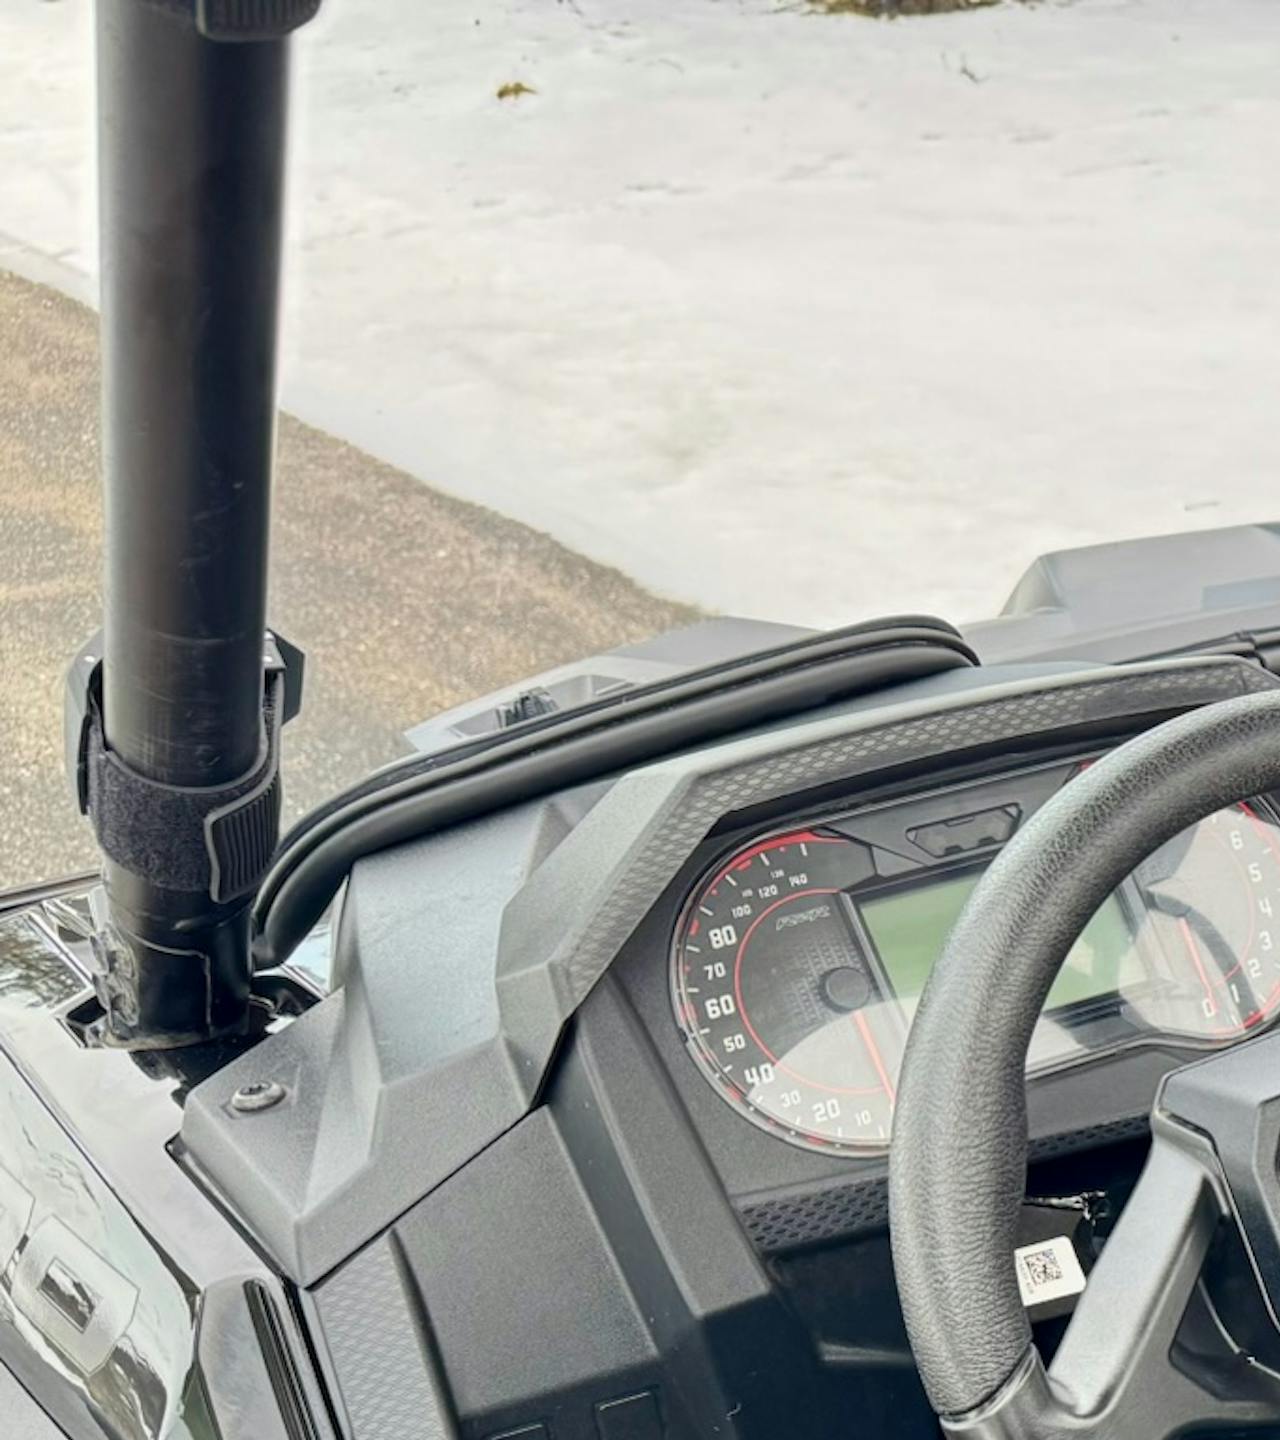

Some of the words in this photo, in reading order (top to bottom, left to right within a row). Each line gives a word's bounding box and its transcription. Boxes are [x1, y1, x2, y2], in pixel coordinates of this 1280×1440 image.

[1230, 830, 1243, 850] 6
[789, 873, 808, 888] 140
[1248, 863, 1262, 882] 5
[758, 884, 778, 899] 120
[731, 904, 752, 919] 100
[1258, 898, 1273, 917] 4
[708, 925, 737, 949] 80
[1259, 931, 1272, 950] 3
[703, 962, 726, 980] 70
[1248, 958, 1262, 978] 2
[1231, 984, 1240, 1003] 1
[705, 994, 735, 1019] 60
[1202, 998, 1215, 1017] 0
[723, 1033, 746, 1052] 50
[744, 1063, 775, 1087] 40
[780, 1090, 802, 1107] 30
[812, 1098, 841, 1122] 20
[855, 1110, 872, 1126] 10
